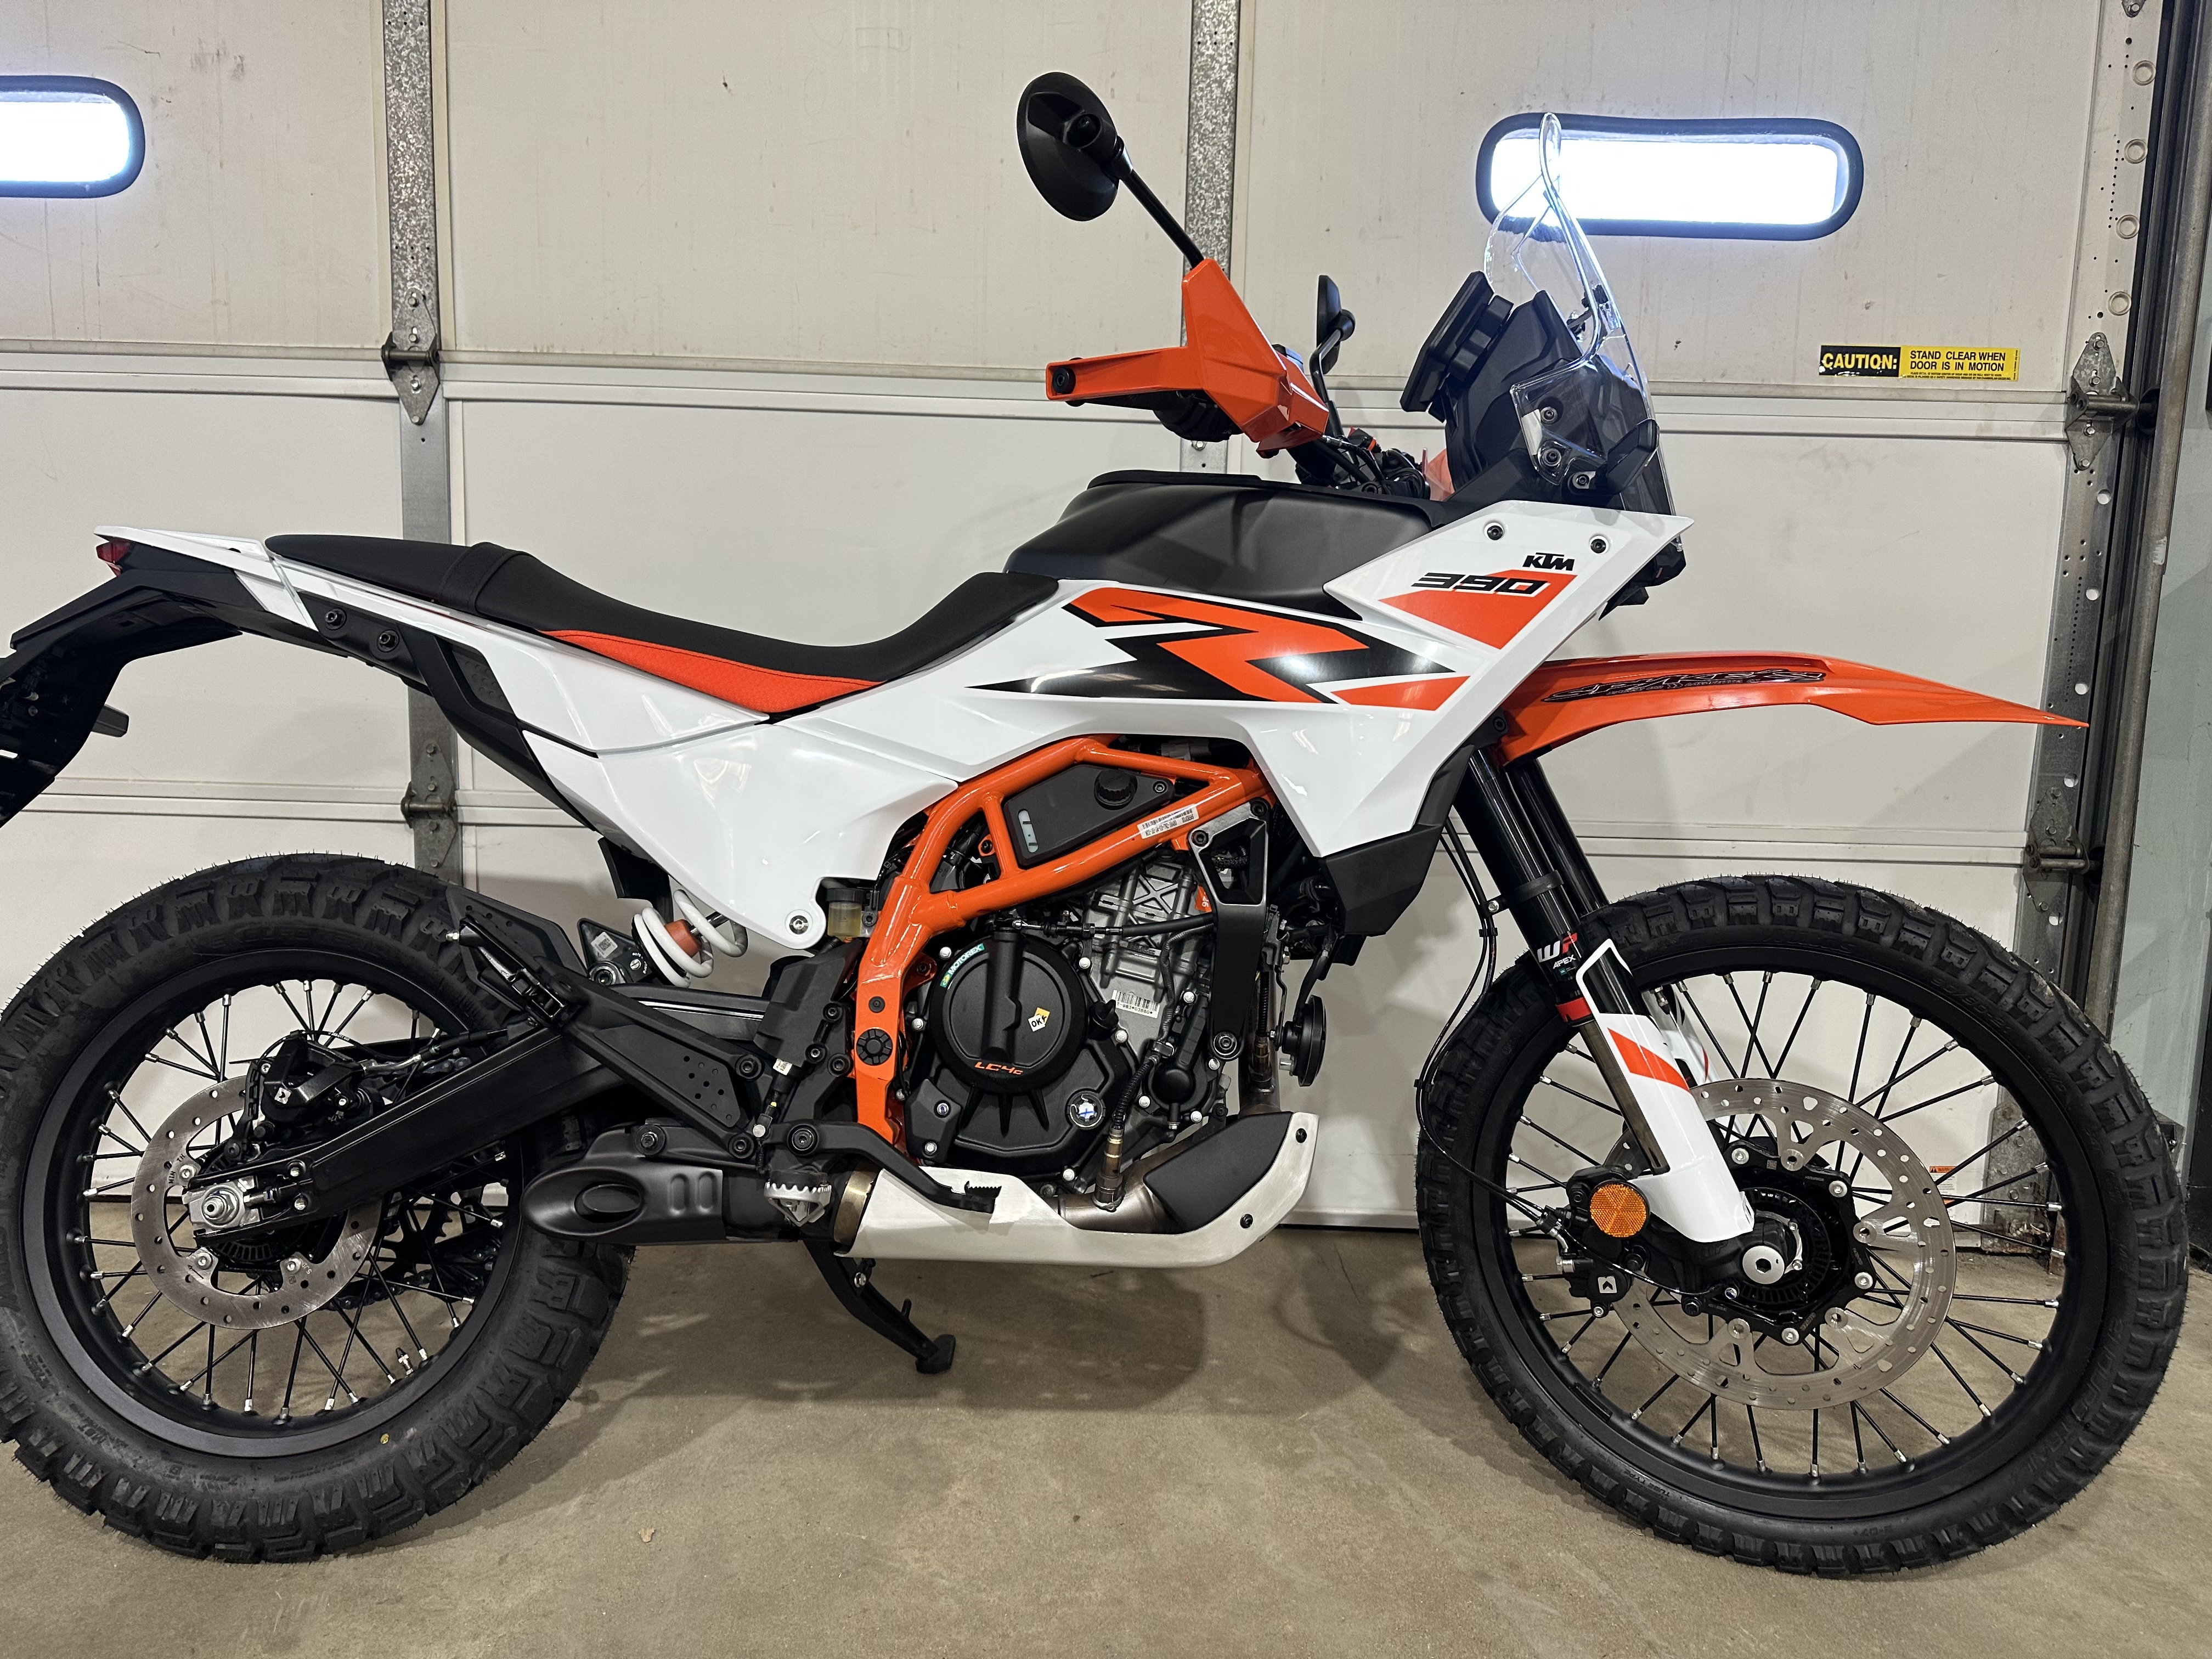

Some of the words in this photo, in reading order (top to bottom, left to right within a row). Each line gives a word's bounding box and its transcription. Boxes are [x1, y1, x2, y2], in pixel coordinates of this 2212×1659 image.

[1822, 353, 1897, 369] CAUTION:
[1910, 351, 1941, 359] STAND
[1945, 352, 1976, 360] CLEAR
[1978, 352, 2006, 361] WHEN
[1910, 361, 1937, 369] DOOR
[1942, 362, 1950, 370] IS
[1955, 362, 1964, 370] IN
[1968, 363, 2004, 371] MOTION
[1522, 552, 1575, 571] KTM
[1411, 573, 1548, 594] 390
[1537, 933, 1577, 962] WP
[948, 944, 984, 975] MOTOREX
[1553, 955, 1576, 969] APEX
[1031, 1018, 1043, 1027] OK
